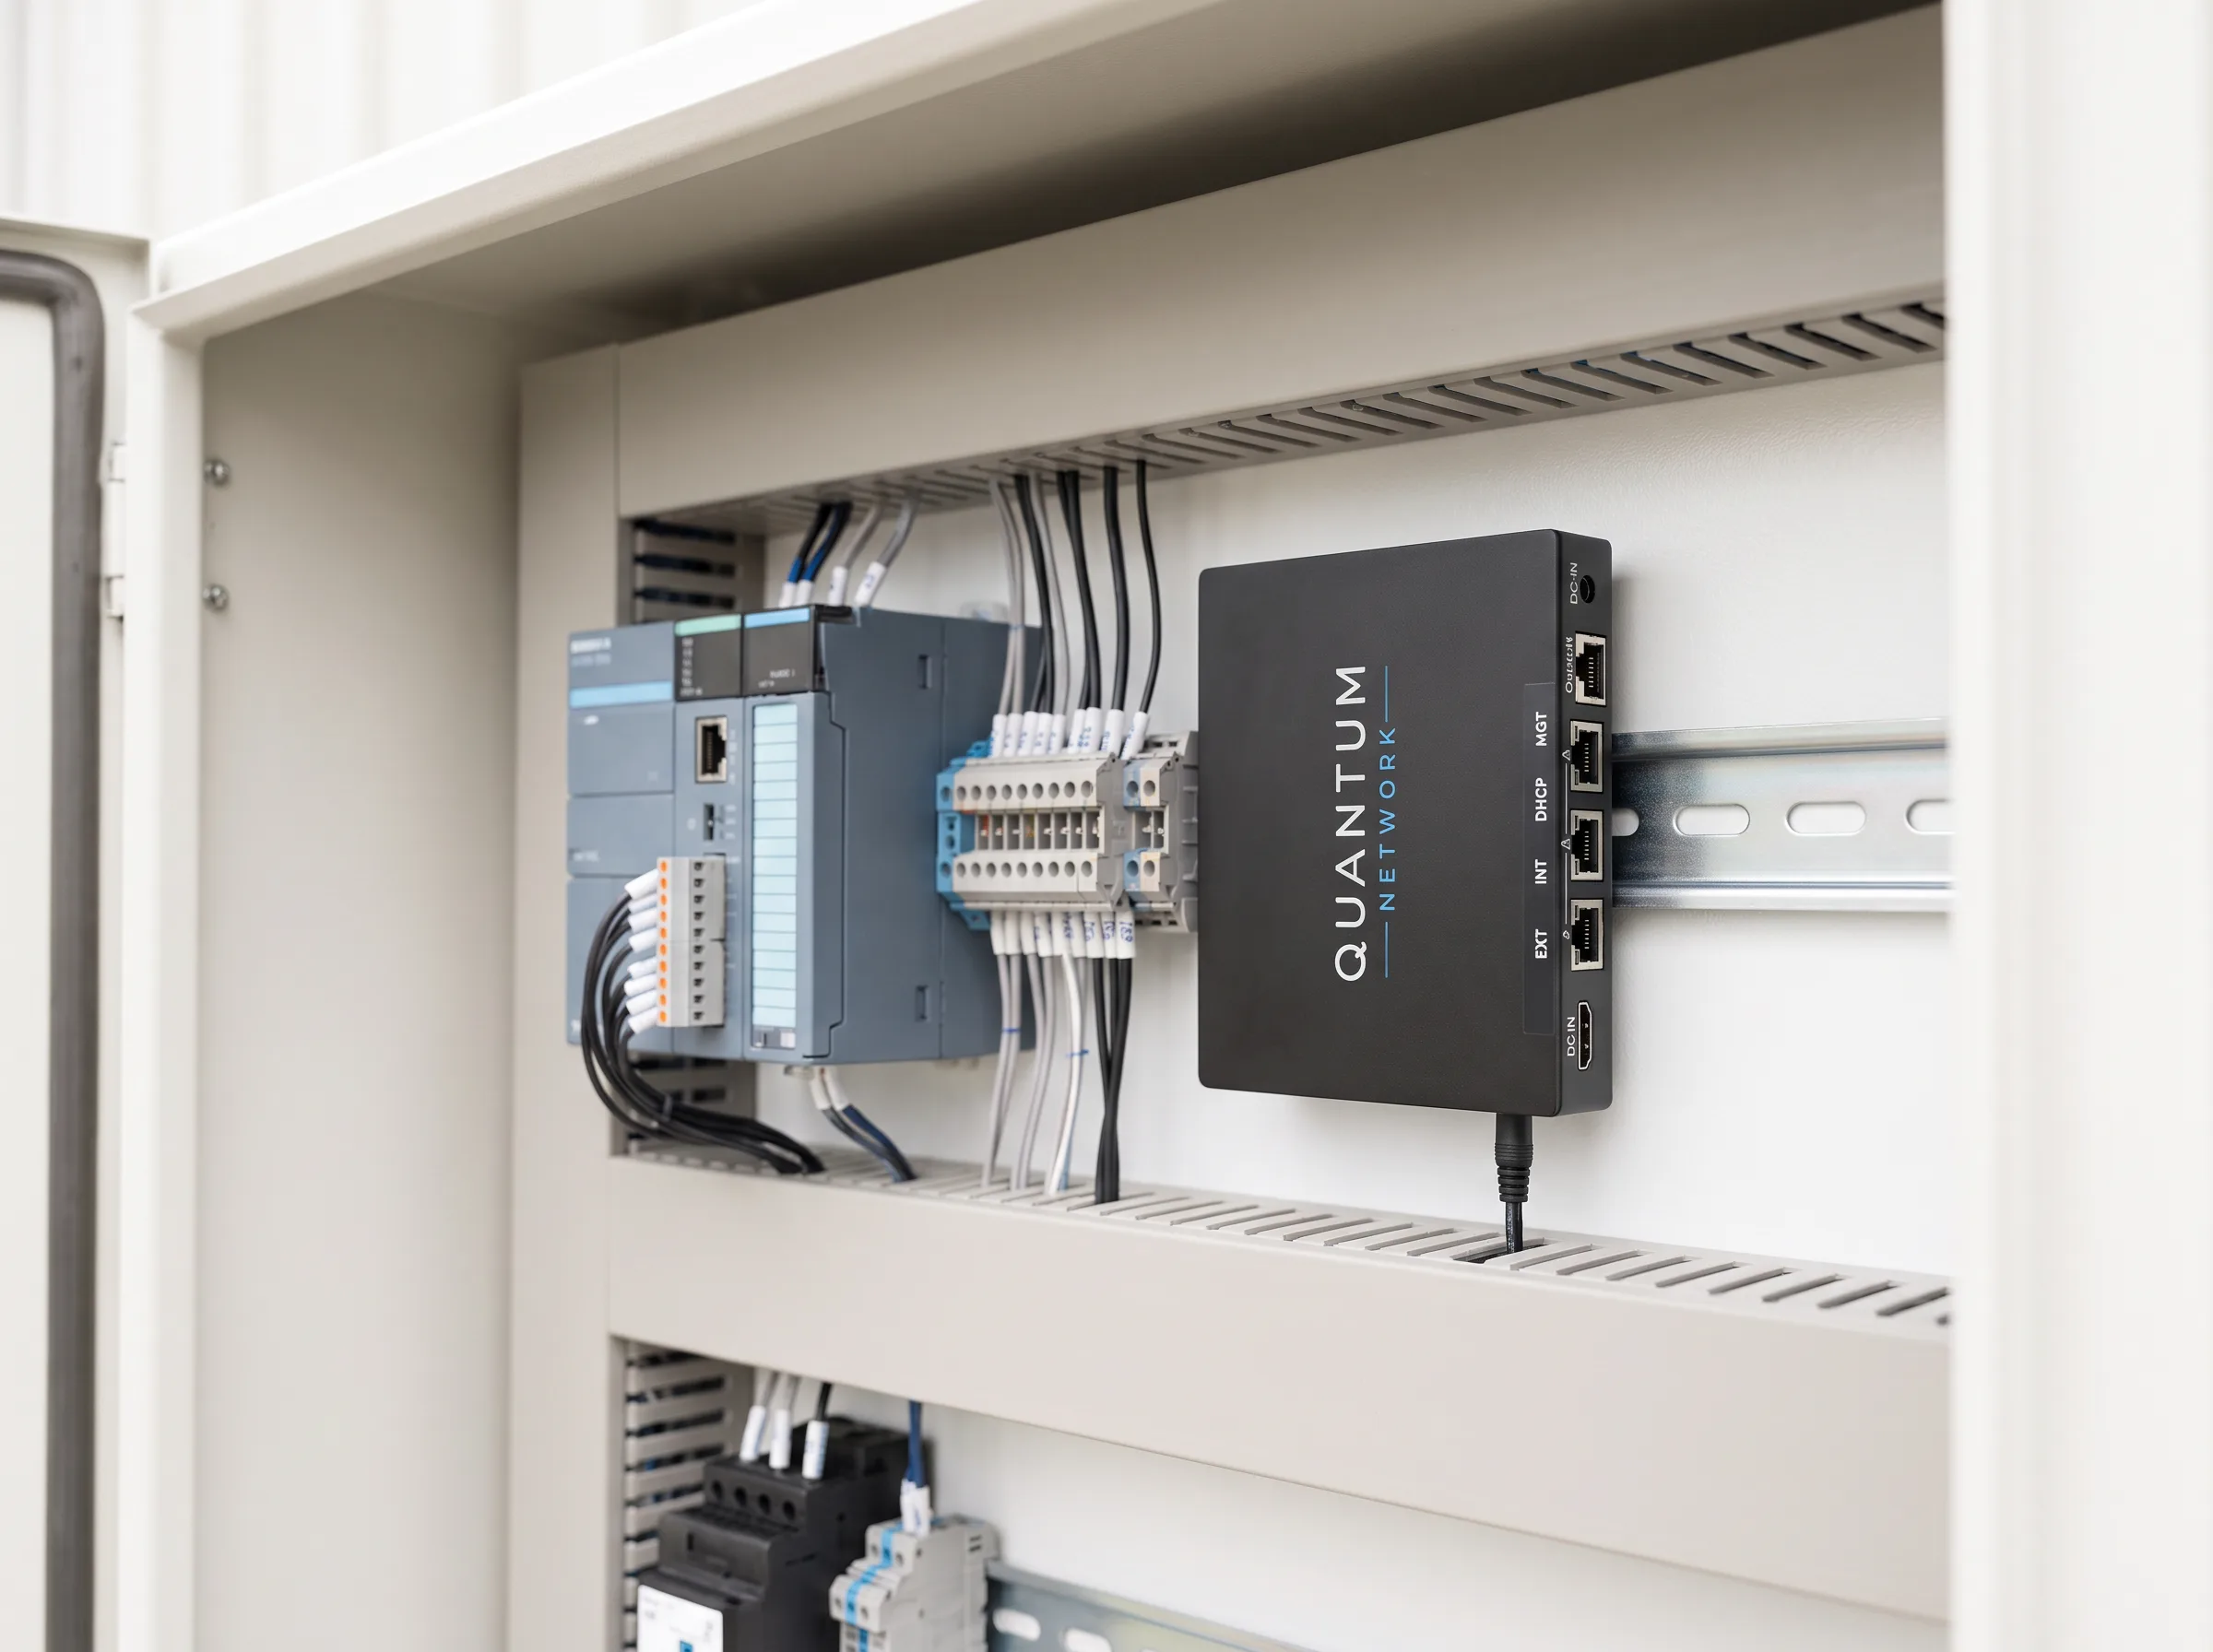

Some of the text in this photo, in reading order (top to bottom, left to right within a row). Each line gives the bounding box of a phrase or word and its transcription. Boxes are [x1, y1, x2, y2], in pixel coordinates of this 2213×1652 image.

[1534, 711, 1547, 747] MGT
[1379, 727, 1396, 911] NETWORK
[1534, 777, 1548, 822] DHCP
[1334, 666, 1367, 982] QUANTUM
[1534, 858, 1547, 885] INT
[1534, 928, 1548, 959] EXT
[1566, 1016, 1576, 1057] DC IN
